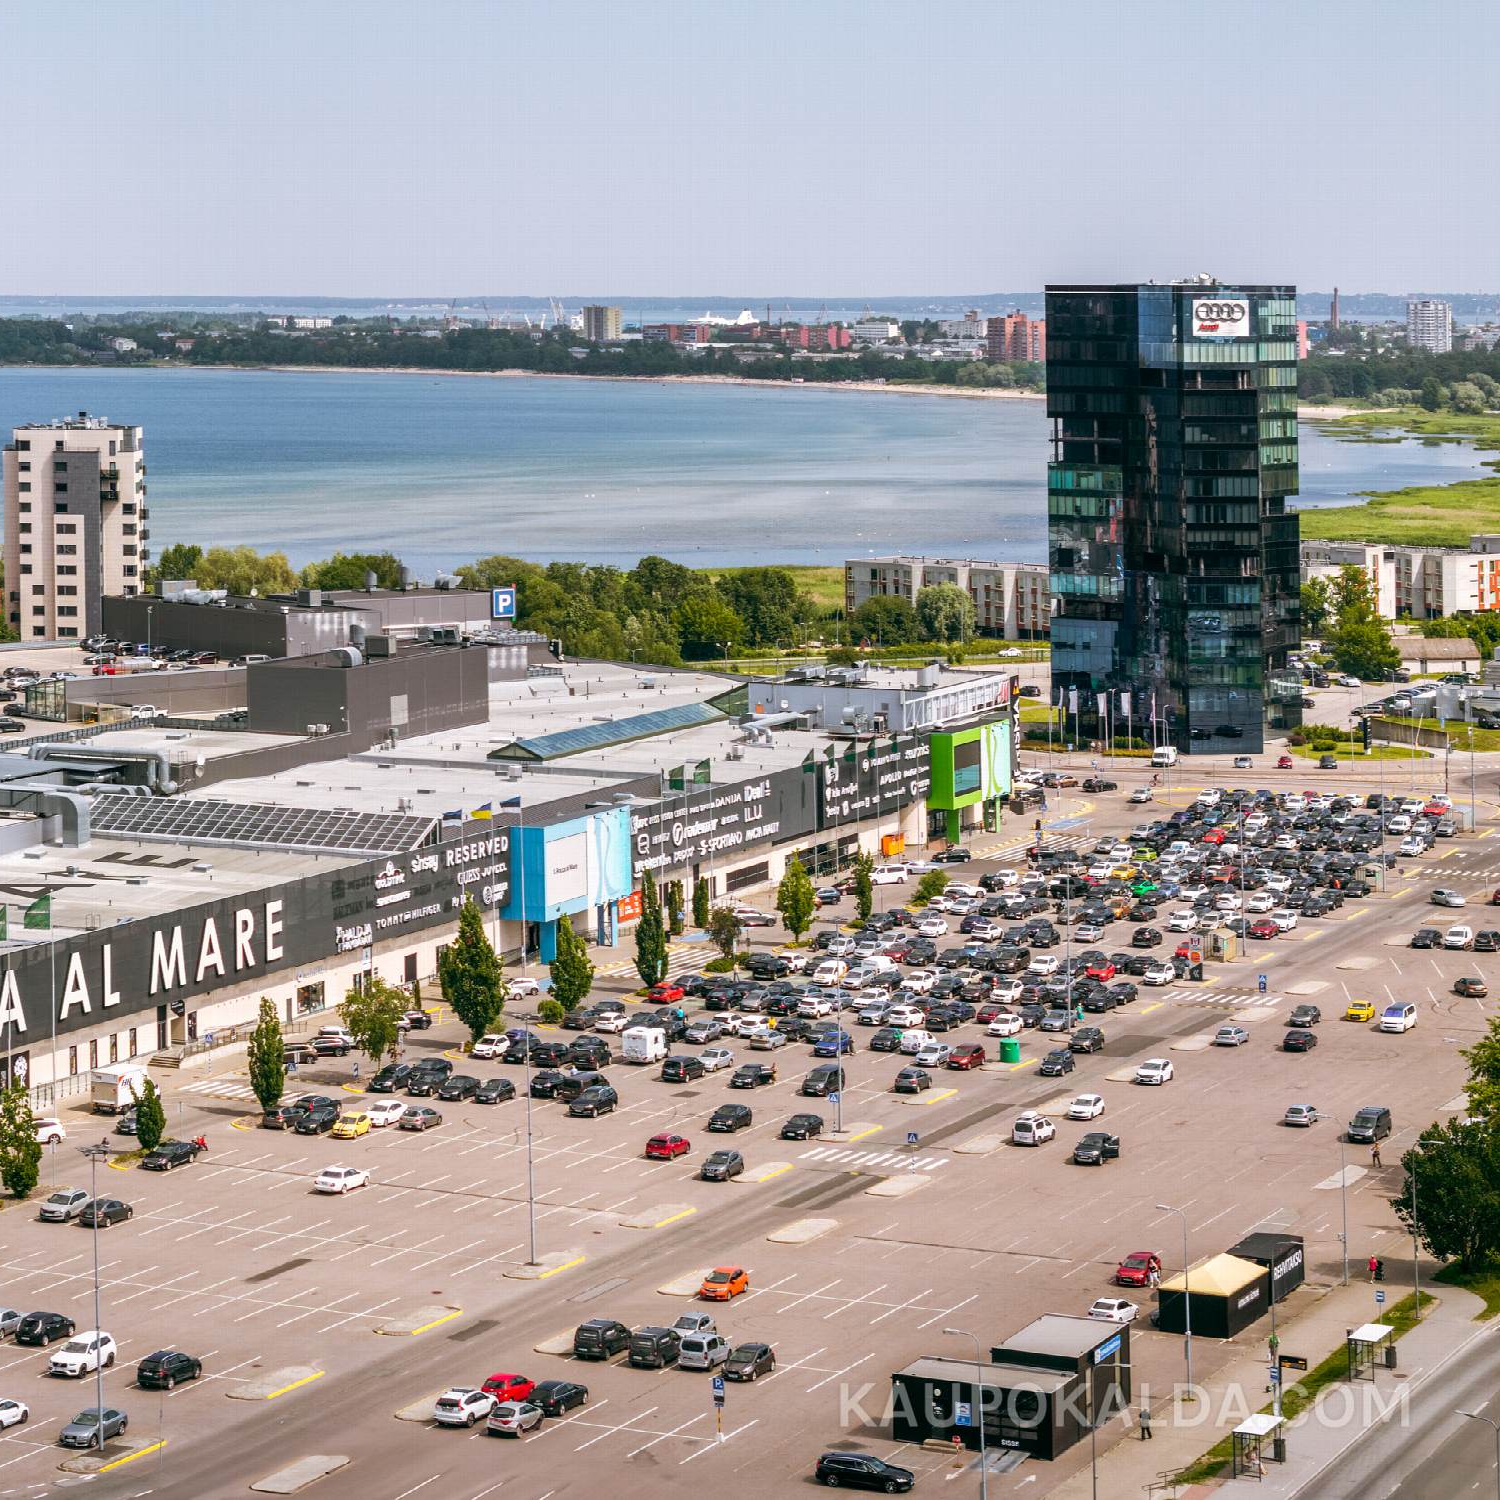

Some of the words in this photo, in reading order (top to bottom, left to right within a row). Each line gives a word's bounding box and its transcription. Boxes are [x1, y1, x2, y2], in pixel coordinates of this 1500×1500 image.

[499, 595, 511, 612] P
[715, 793, 742, 808] DANIJA
[445, 836, 509, 867] RESERVED
[375, 913, 404, 929] TOMMY
[59, 950, 121, 1020] AL
[149, 898, 284, 996] MARE
